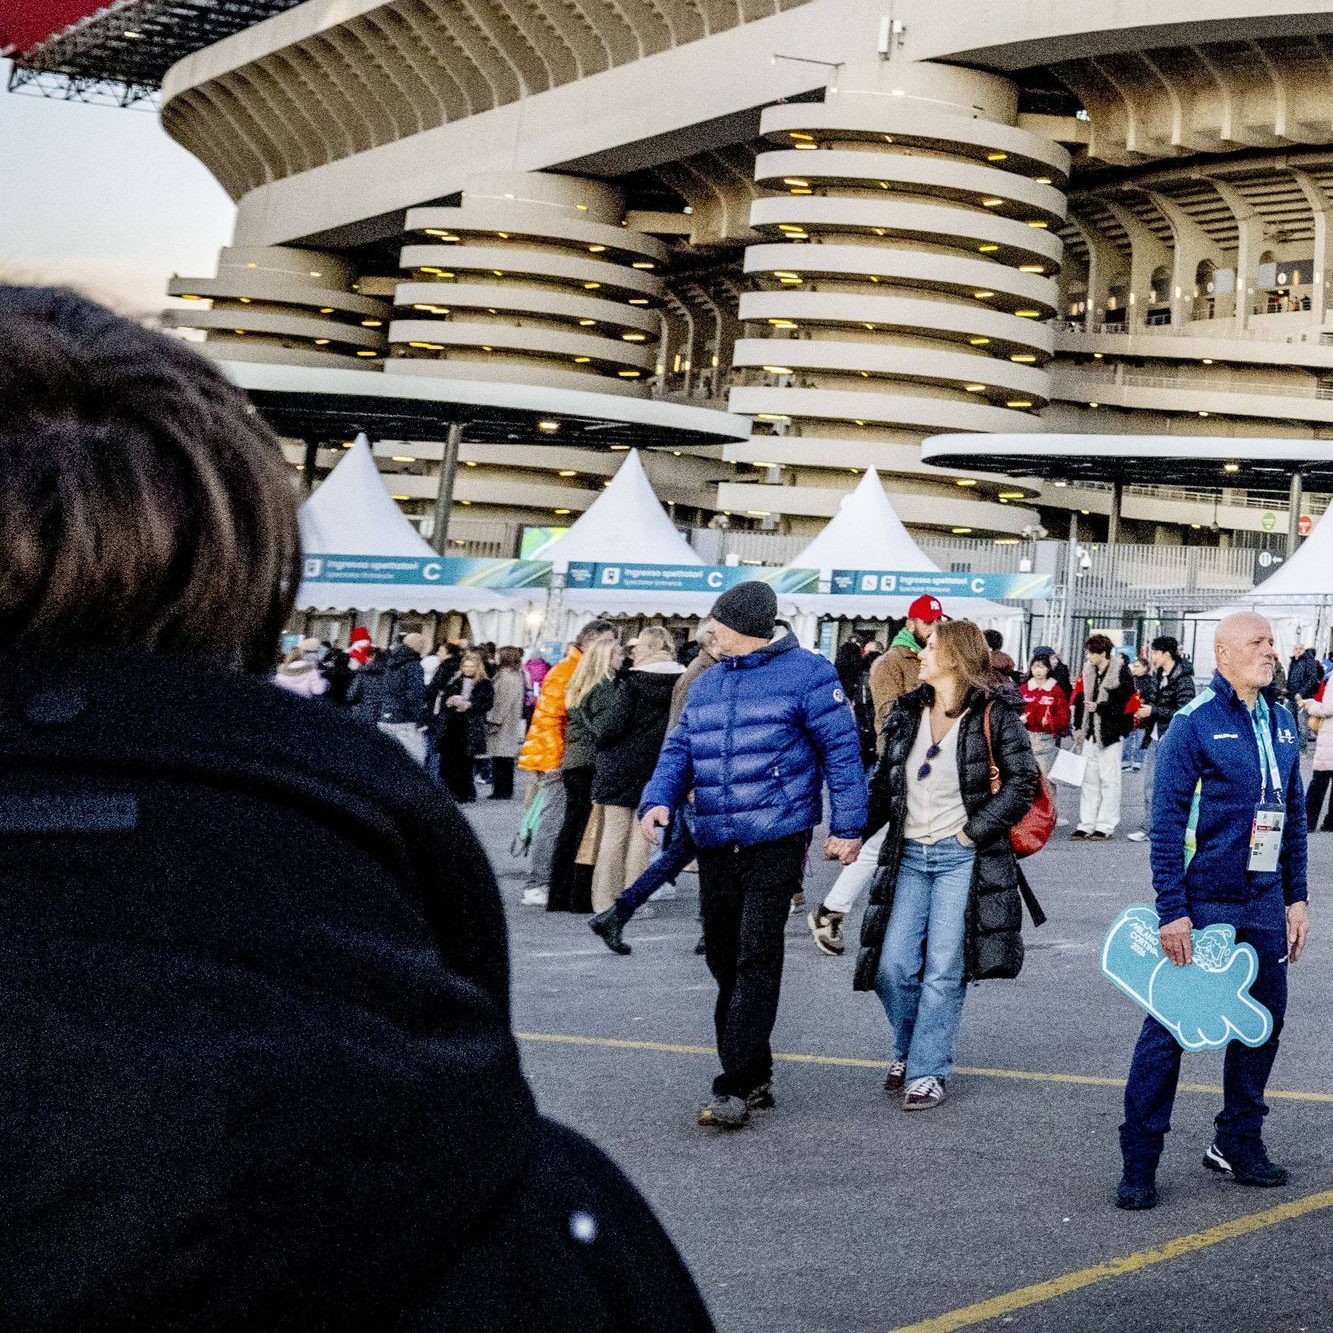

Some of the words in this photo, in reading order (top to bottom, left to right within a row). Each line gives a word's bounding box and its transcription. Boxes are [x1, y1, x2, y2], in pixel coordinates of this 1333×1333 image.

[423, 563, 441, 580] C
[707, 571, 723, 588] C
[970, 578, 985, 593] C
[1130, 923, 1159, 946] MILANO
[1130, 931, 1159, 958] CORTINA
